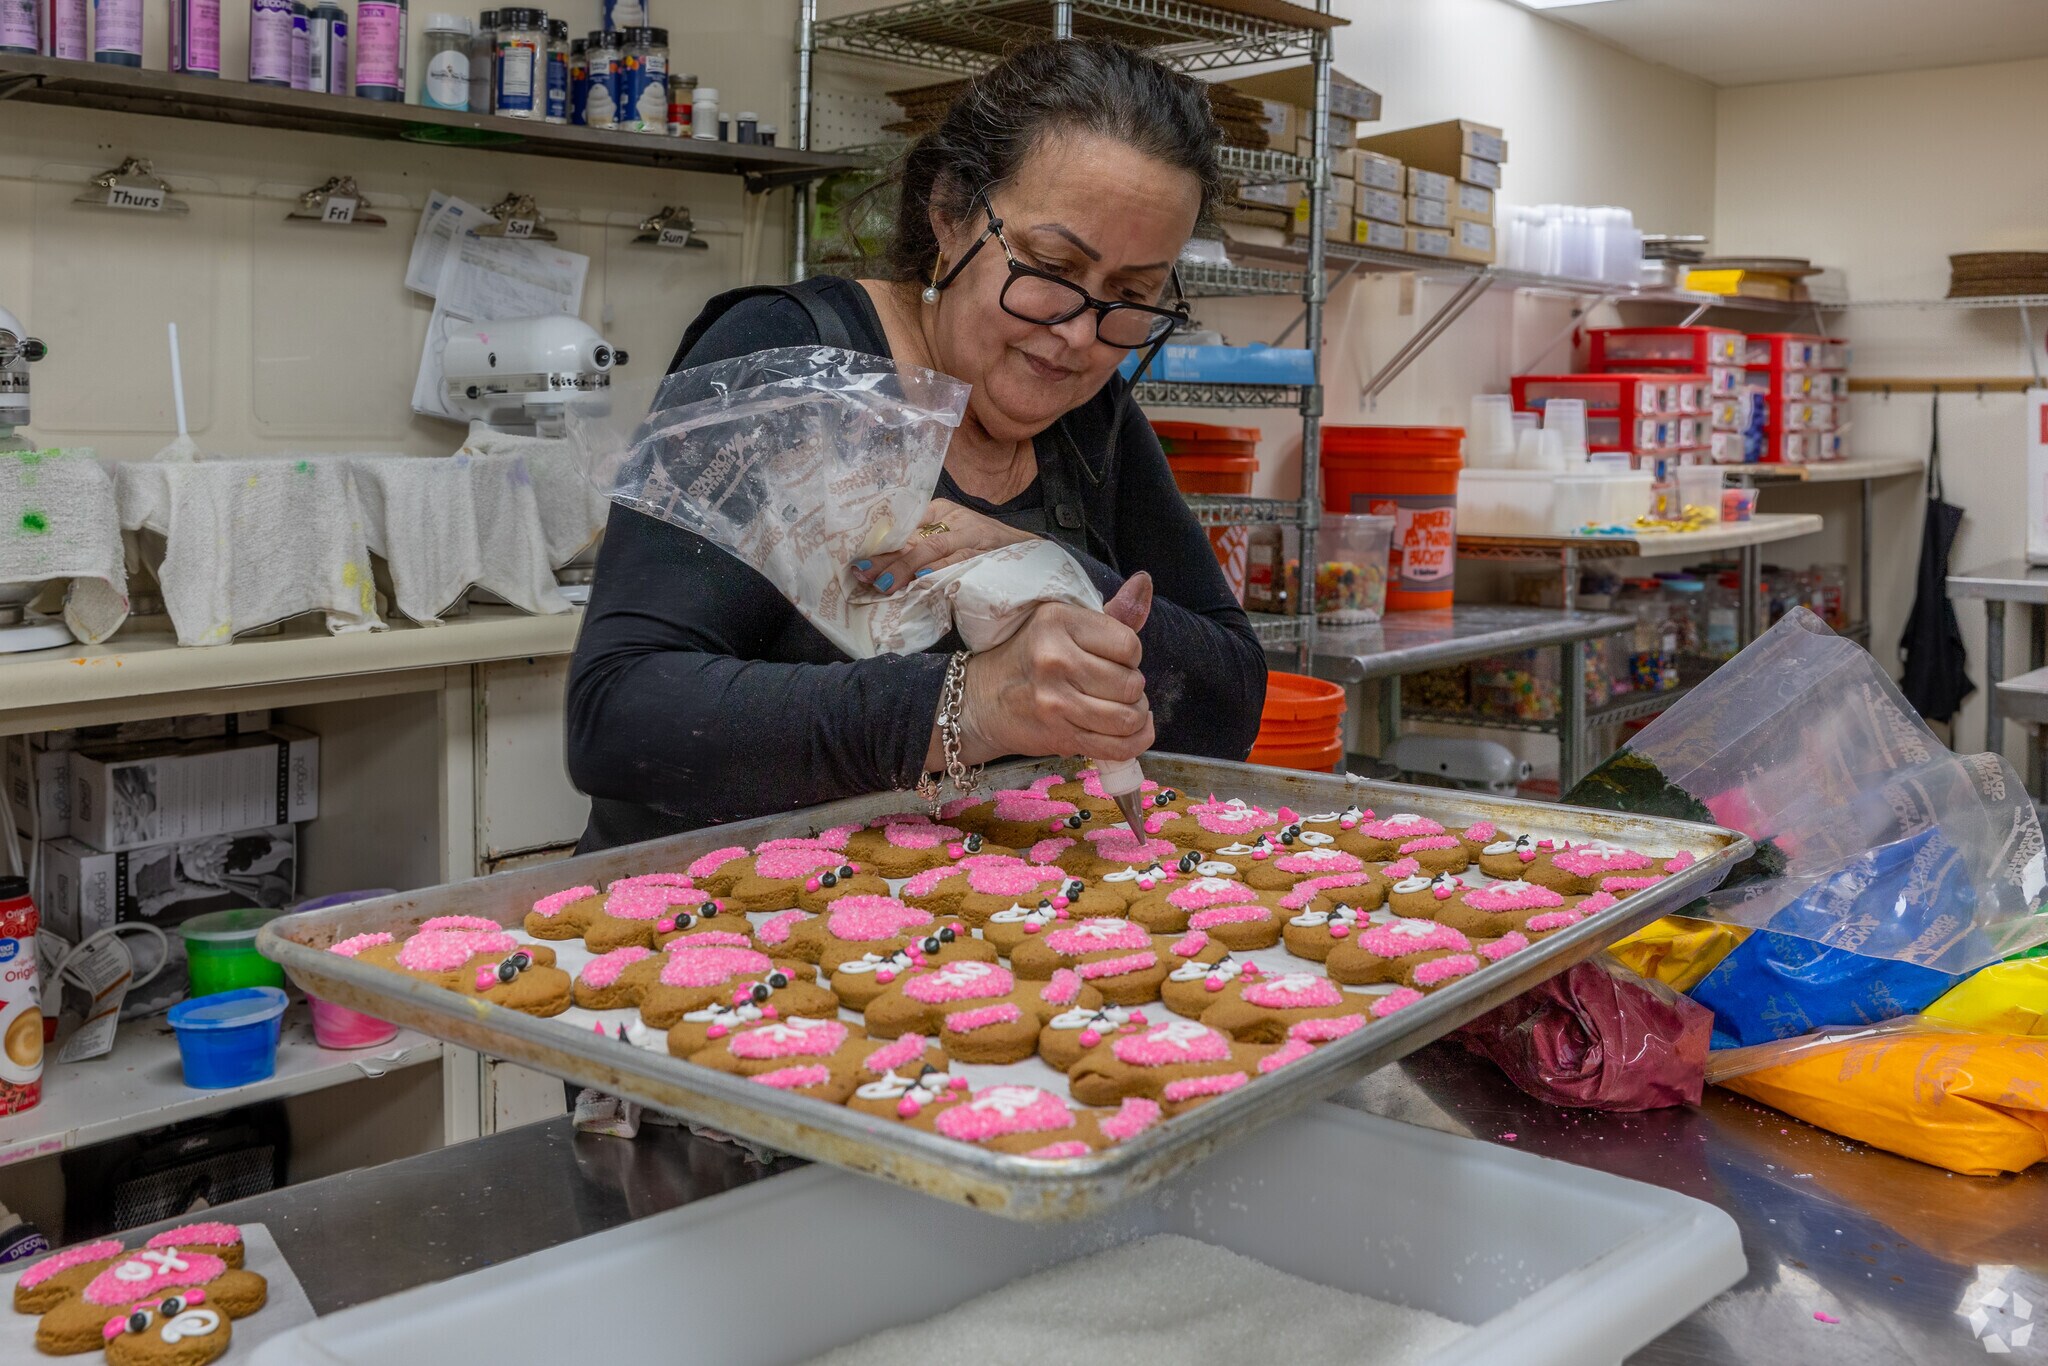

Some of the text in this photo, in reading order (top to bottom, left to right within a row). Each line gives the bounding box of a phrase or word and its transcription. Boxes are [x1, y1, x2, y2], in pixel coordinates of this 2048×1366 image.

[113, 191, 160, 208] Thurs
[329, 207, 349, 220] Fri
[509, 221, 531, 234] Sat
[662, 231, 684, 244] Sun
